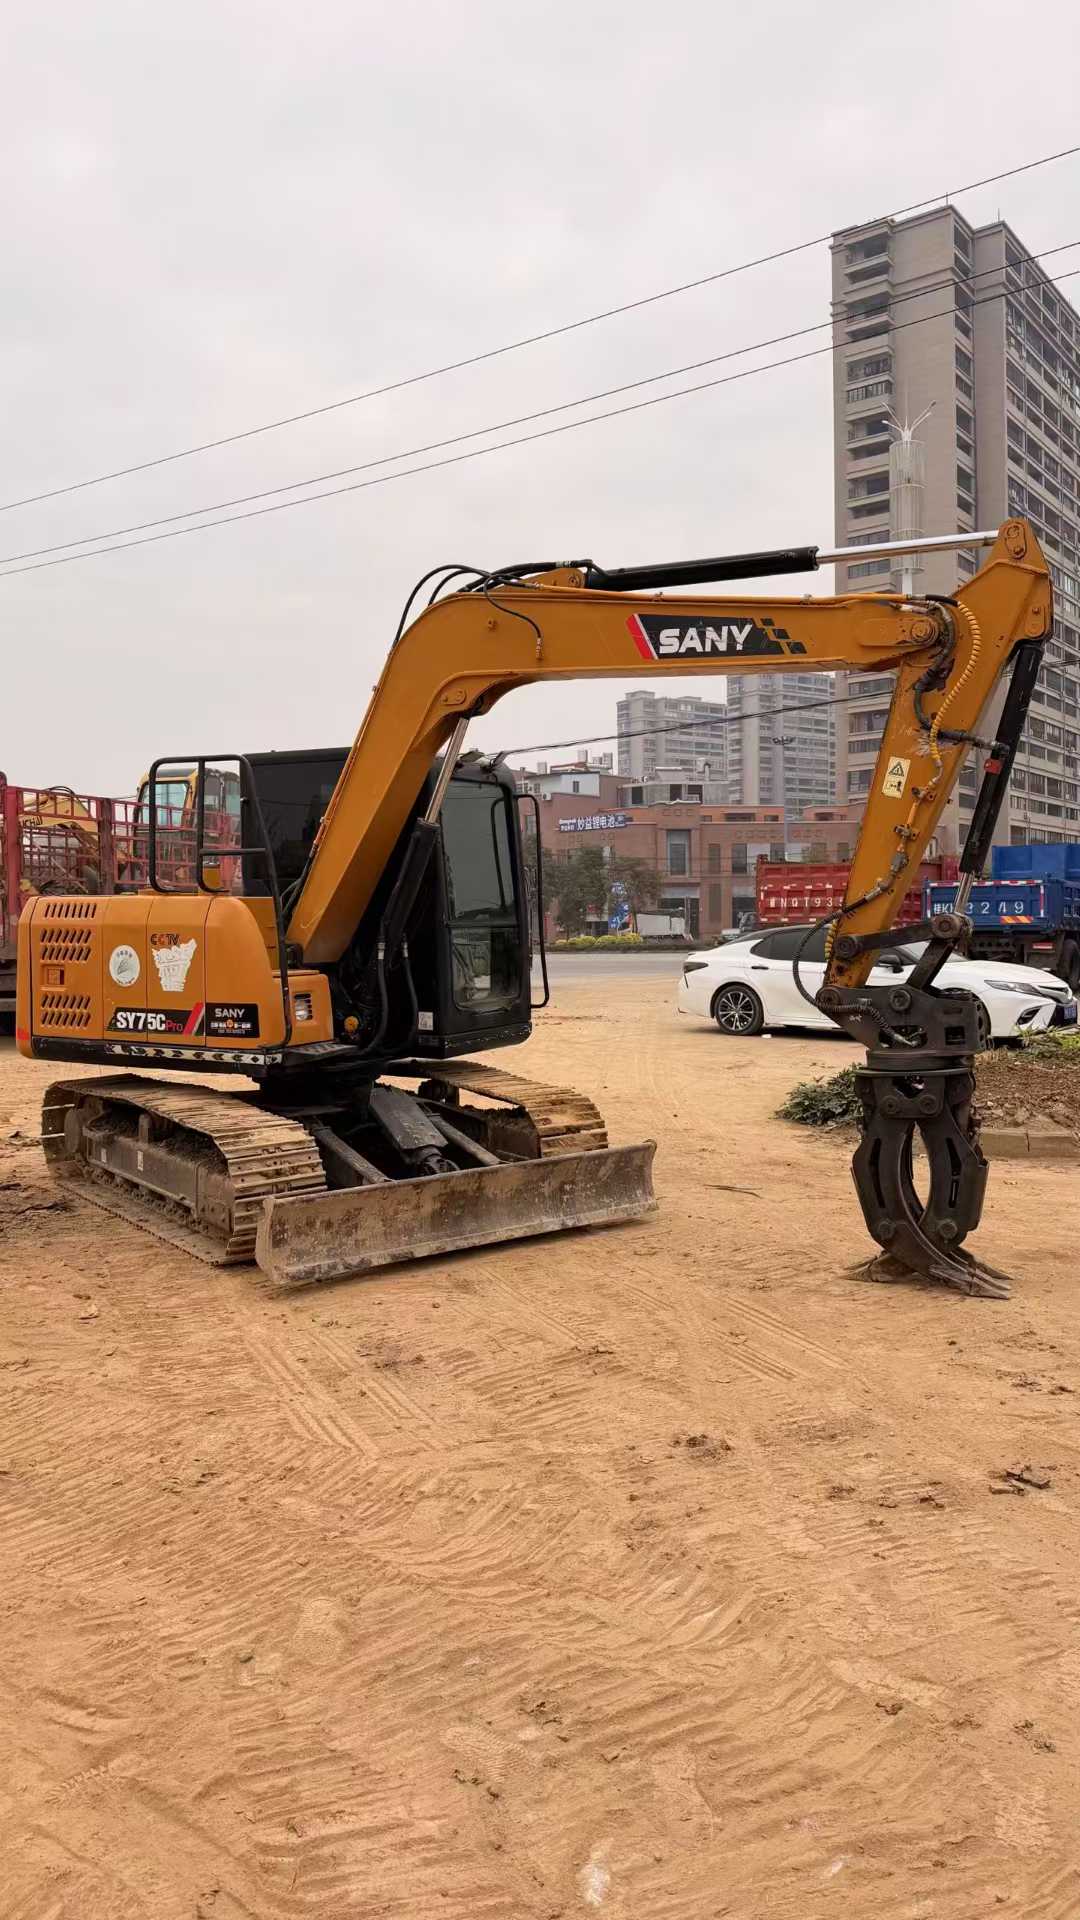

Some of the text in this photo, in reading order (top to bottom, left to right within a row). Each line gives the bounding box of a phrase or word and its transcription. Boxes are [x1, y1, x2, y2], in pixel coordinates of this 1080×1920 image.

[659, 624, 753, 654] SANY
[933, 901, 1024, 914] 桂K3249
[214, 1008, 245, 1018] SANY
